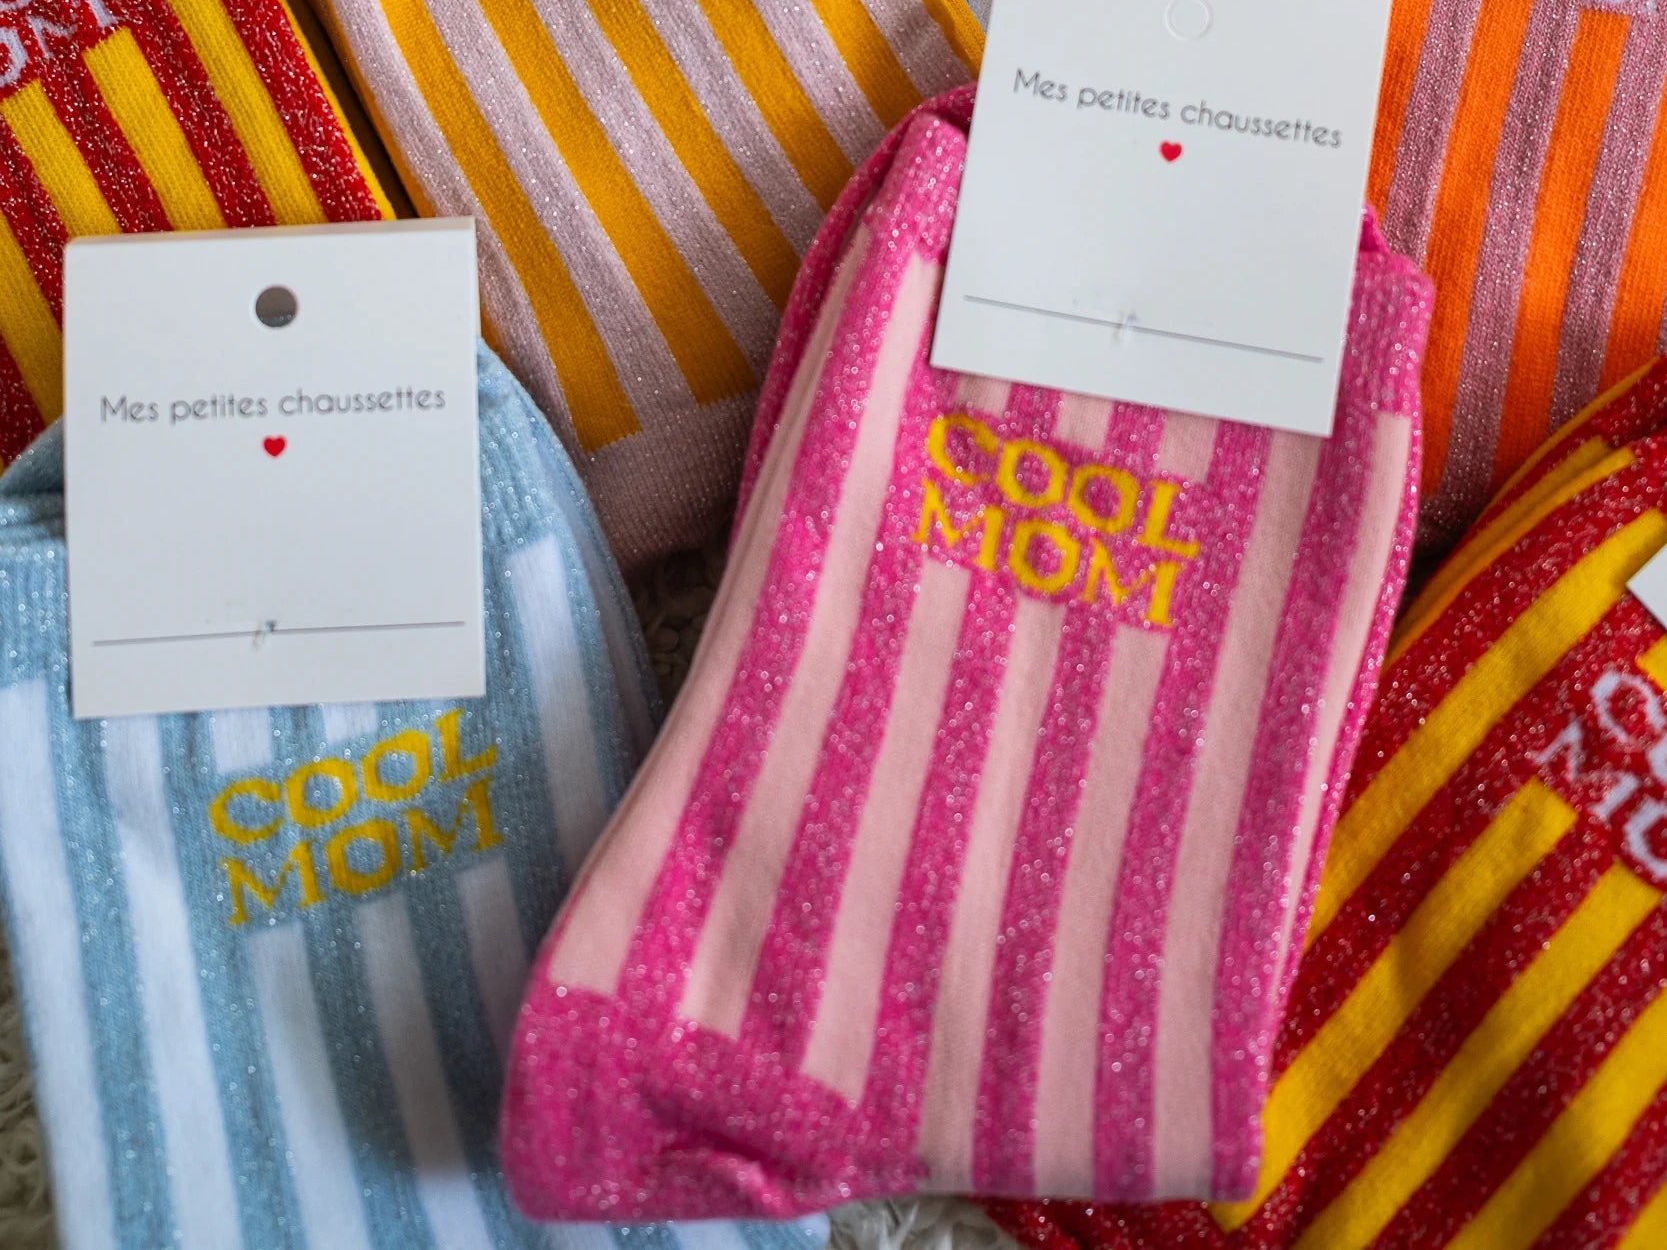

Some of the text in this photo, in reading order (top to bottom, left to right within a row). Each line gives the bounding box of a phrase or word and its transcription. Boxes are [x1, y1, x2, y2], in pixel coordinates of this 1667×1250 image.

[1012, 66, 1344, 149] Mes petites chaussettes
[99, 385, 447, 427] Mes petites chaussettes
[911, 476, 1185, 627] MOM
[926, 412, 1201, 559] COOL
[207, 707, 498, 846] COOL
[219, 773, 505, 927] MOM
